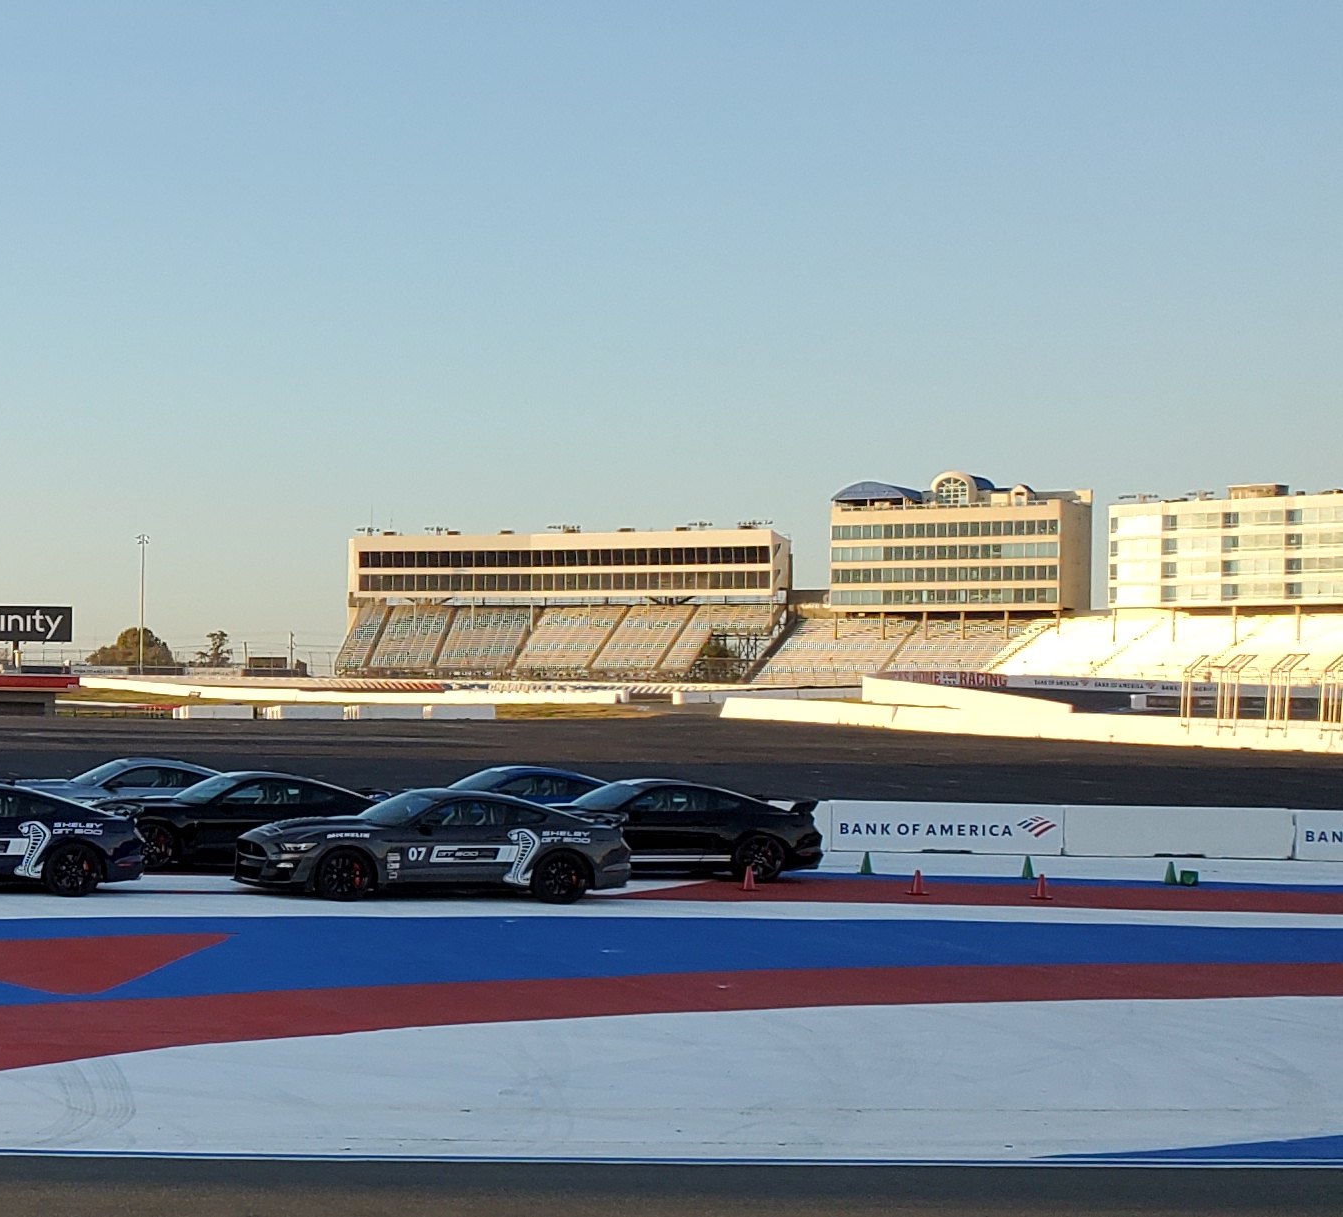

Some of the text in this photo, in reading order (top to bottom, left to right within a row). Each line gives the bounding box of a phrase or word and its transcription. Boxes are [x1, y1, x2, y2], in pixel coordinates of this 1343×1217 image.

[959, 672, 1007, 687] RACING
[839, 823, 1013, 837] BANK OF AMERICA
[1305, 831, 1343, 842] BAN
[408, 847, 427, 861] 07
